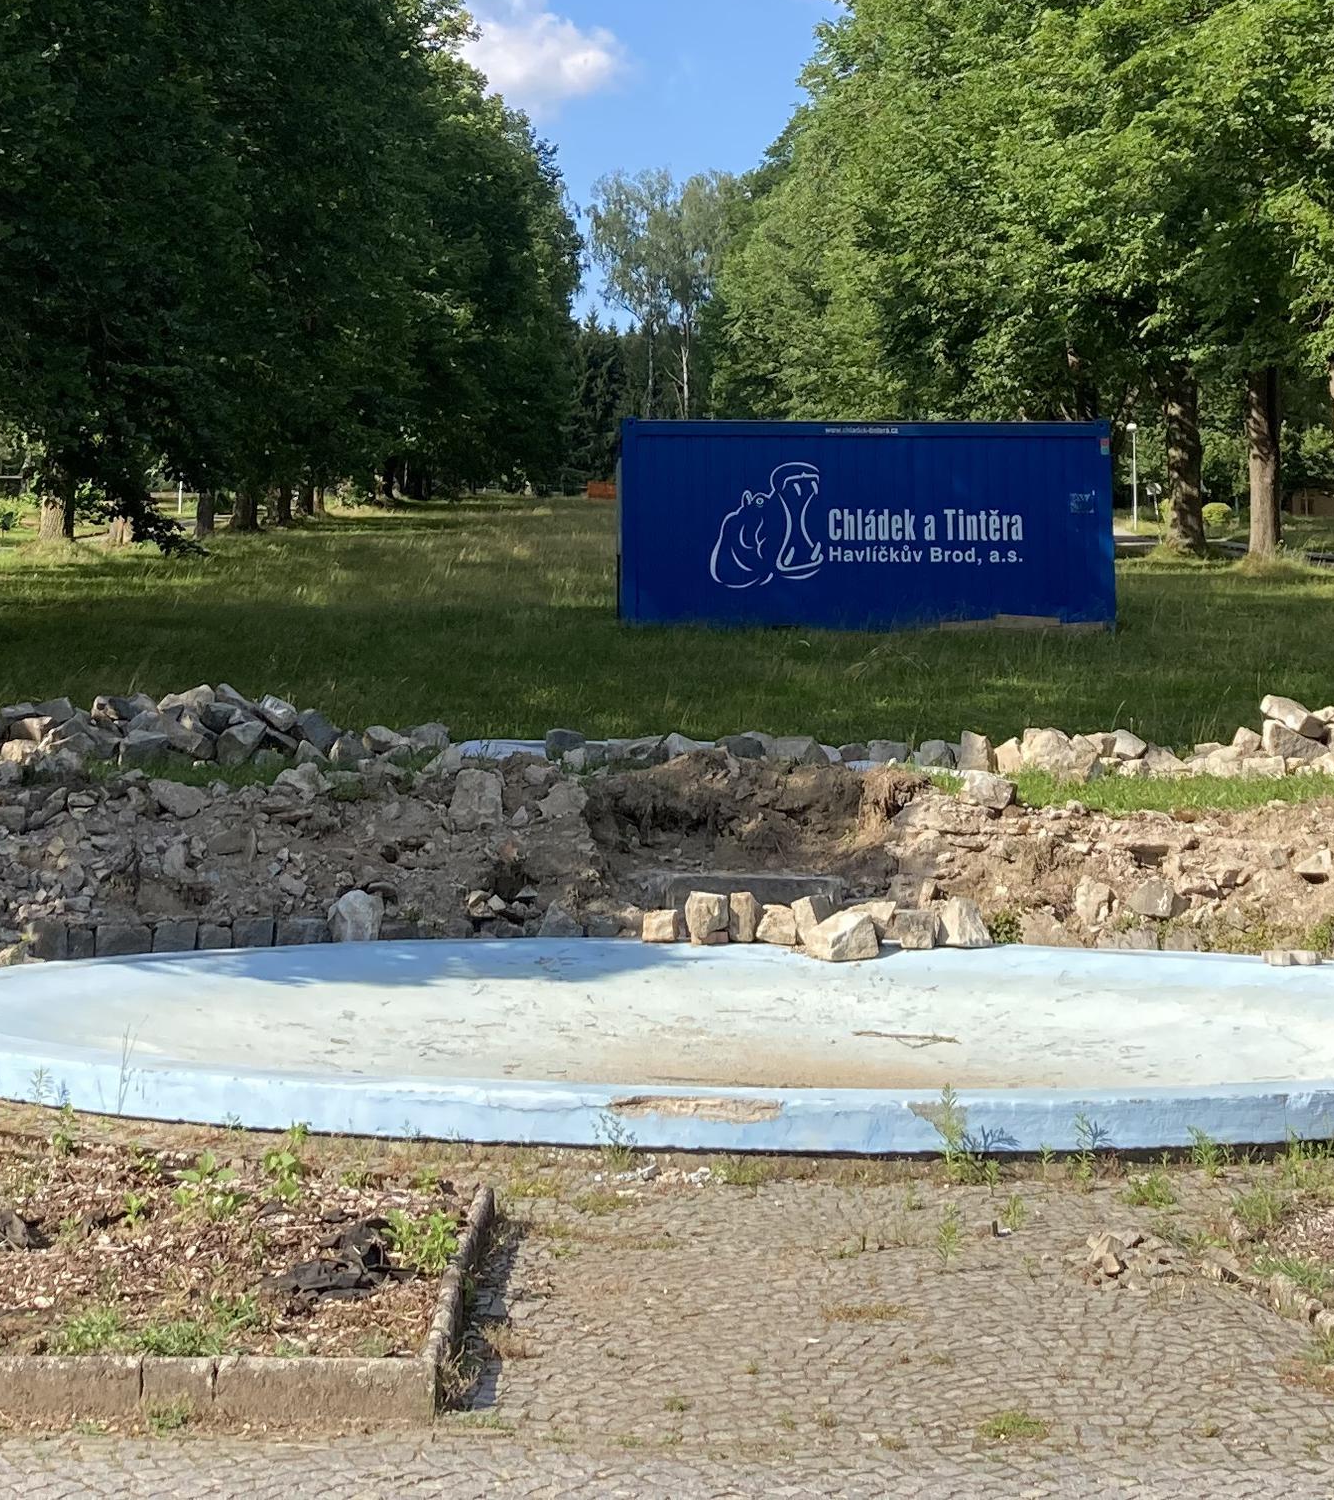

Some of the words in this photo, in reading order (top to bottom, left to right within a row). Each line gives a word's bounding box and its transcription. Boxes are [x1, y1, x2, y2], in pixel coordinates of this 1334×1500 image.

[828, 508, 916, 541] Chládek
[924, 514, 936, 541] a
[943, 508, 1023, 541] Tintěra
[829, 545, 923, 563] Havlíčkův
[930, 547, 982, 566] Brod,
[989, 550, 1023, 563] a.s.
